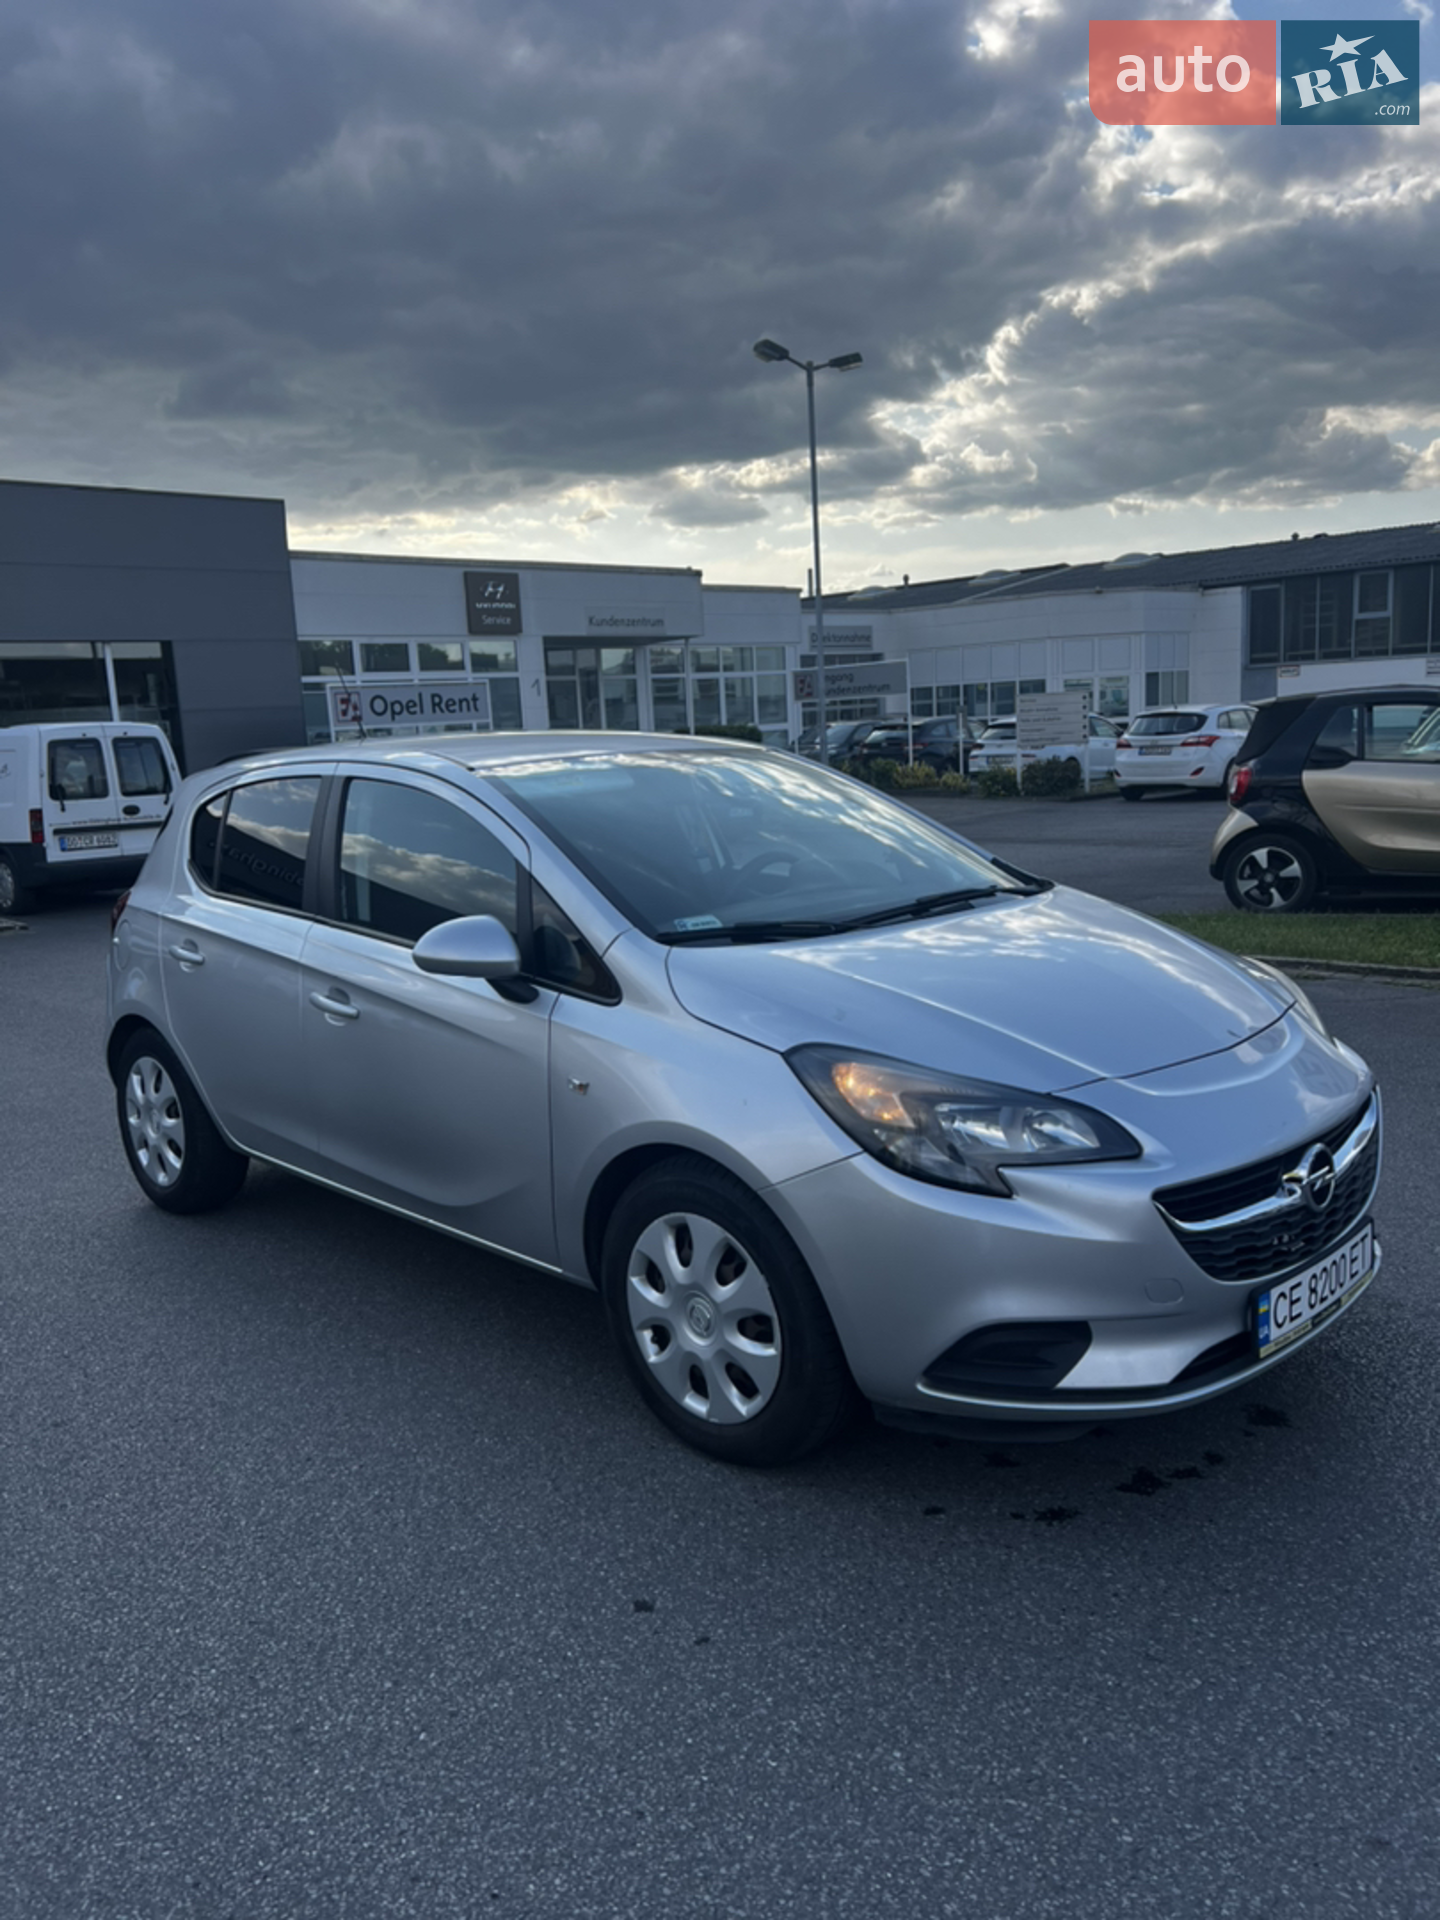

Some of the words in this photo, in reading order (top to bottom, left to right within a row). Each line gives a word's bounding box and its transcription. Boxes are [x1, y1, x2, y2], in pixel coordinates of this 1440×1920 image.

[482, 614, 512, 625] Service
[588, 616, 665, 628] Kundenzentrum
[531, 678, 541, 697] 1
[369, 692, 424, 721] Opel
[430, 692, 480, 714] Rent
[1273, 1281, 1303, 1329] CE
[1308, 1253, 1347, 1310] 8200
[1350, 1233, 1369, 1279] ET
